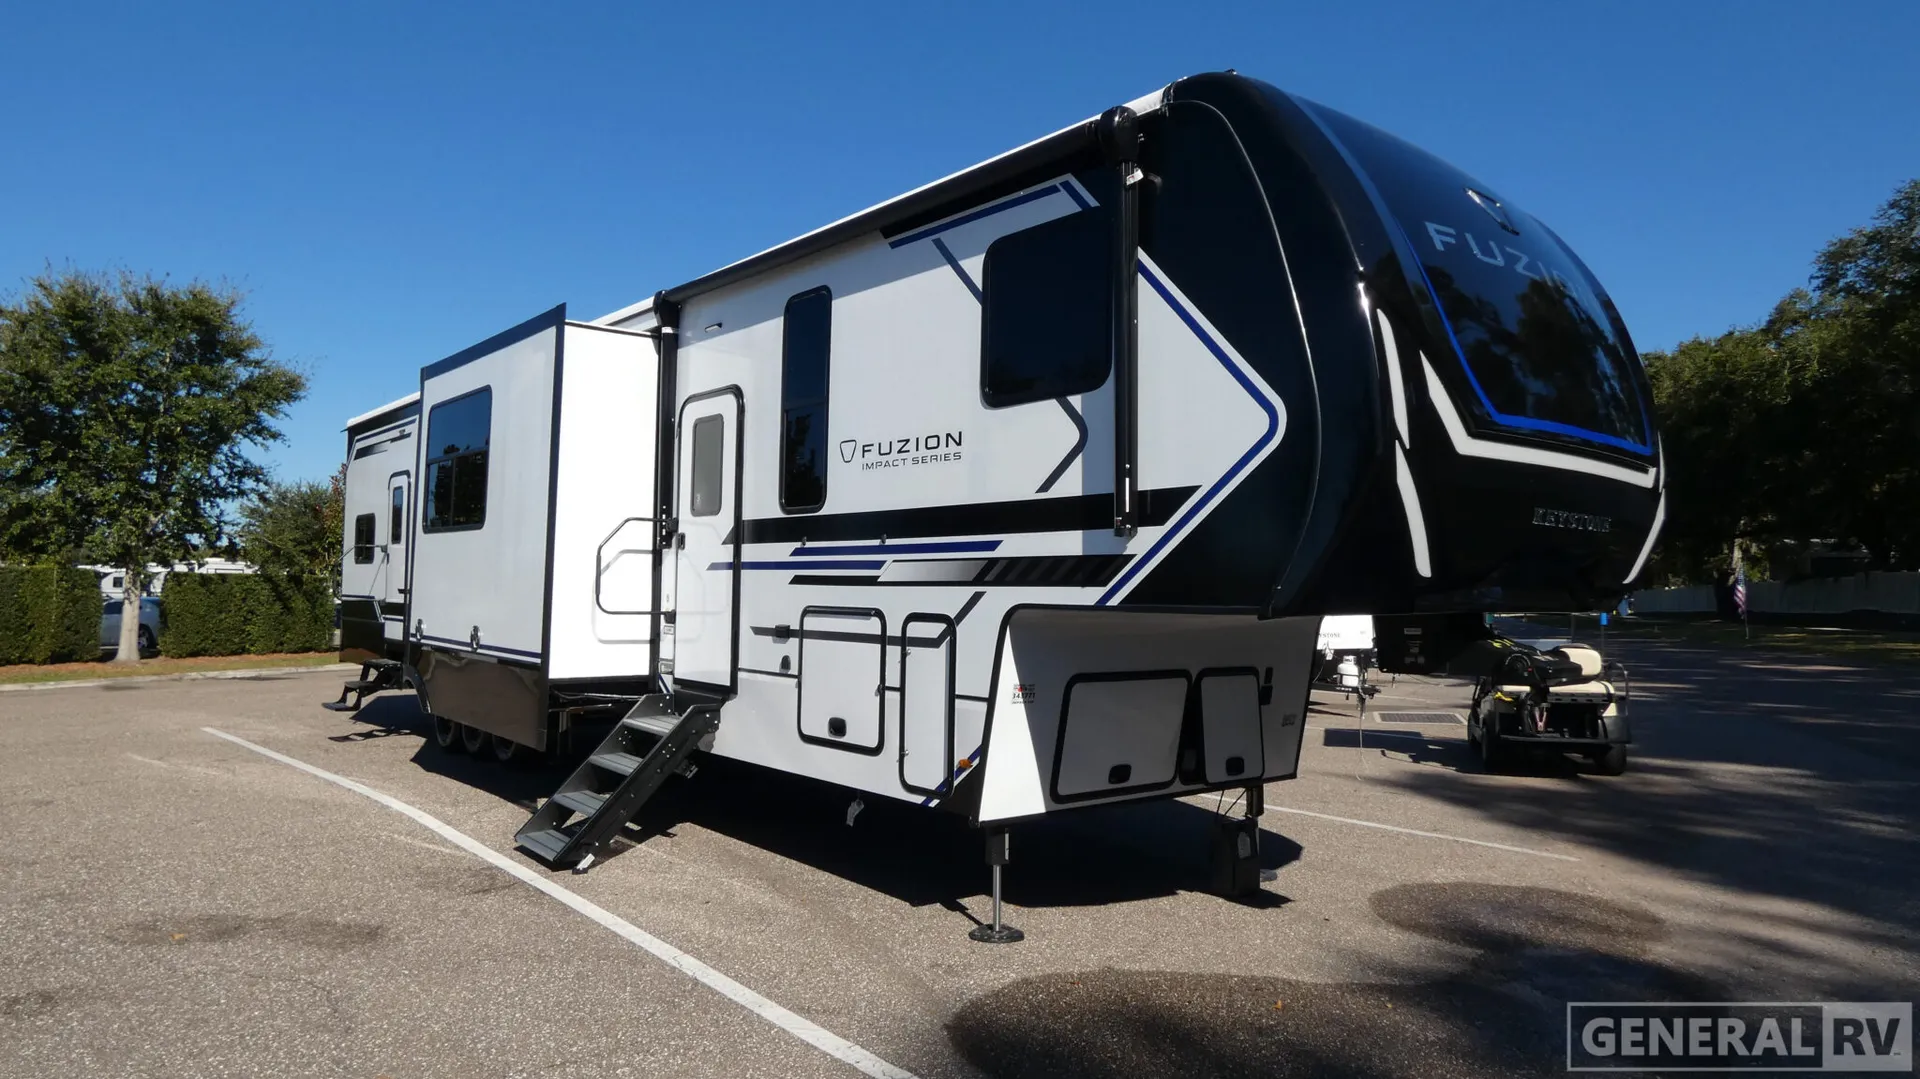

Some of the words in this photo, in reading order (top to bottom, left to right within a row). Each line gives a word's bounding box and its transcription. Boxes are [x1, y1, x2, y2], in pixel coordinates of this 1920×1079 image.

[861, 431, 962, 458] FUZION
[862, 458, 908, 471] IMPACT
[912, 452, 962, 465] SERIES
